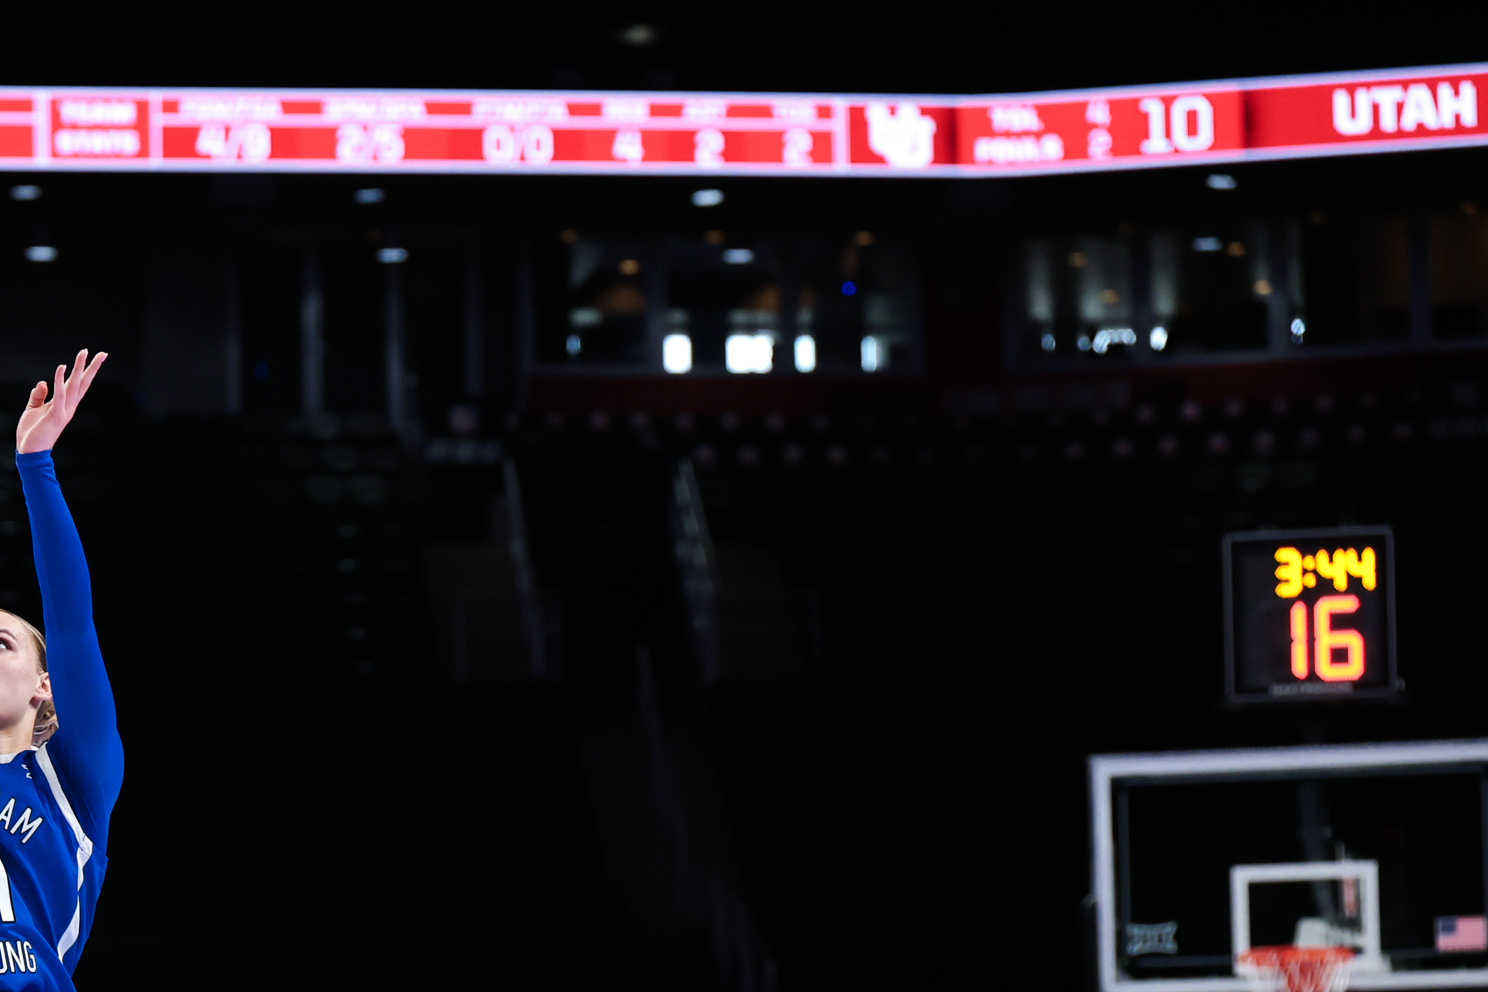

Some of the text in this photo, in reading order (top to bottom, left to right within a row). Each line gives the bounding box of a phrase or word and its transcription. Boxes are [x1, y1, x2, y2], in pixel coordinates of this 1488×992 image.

[1139, 95, 1214, 154] 10
[1332, 81, 1478, 136] UTAH
[1274, 546, 1377, 598] 3:44
[1290, 594, 1366, 682] 16
